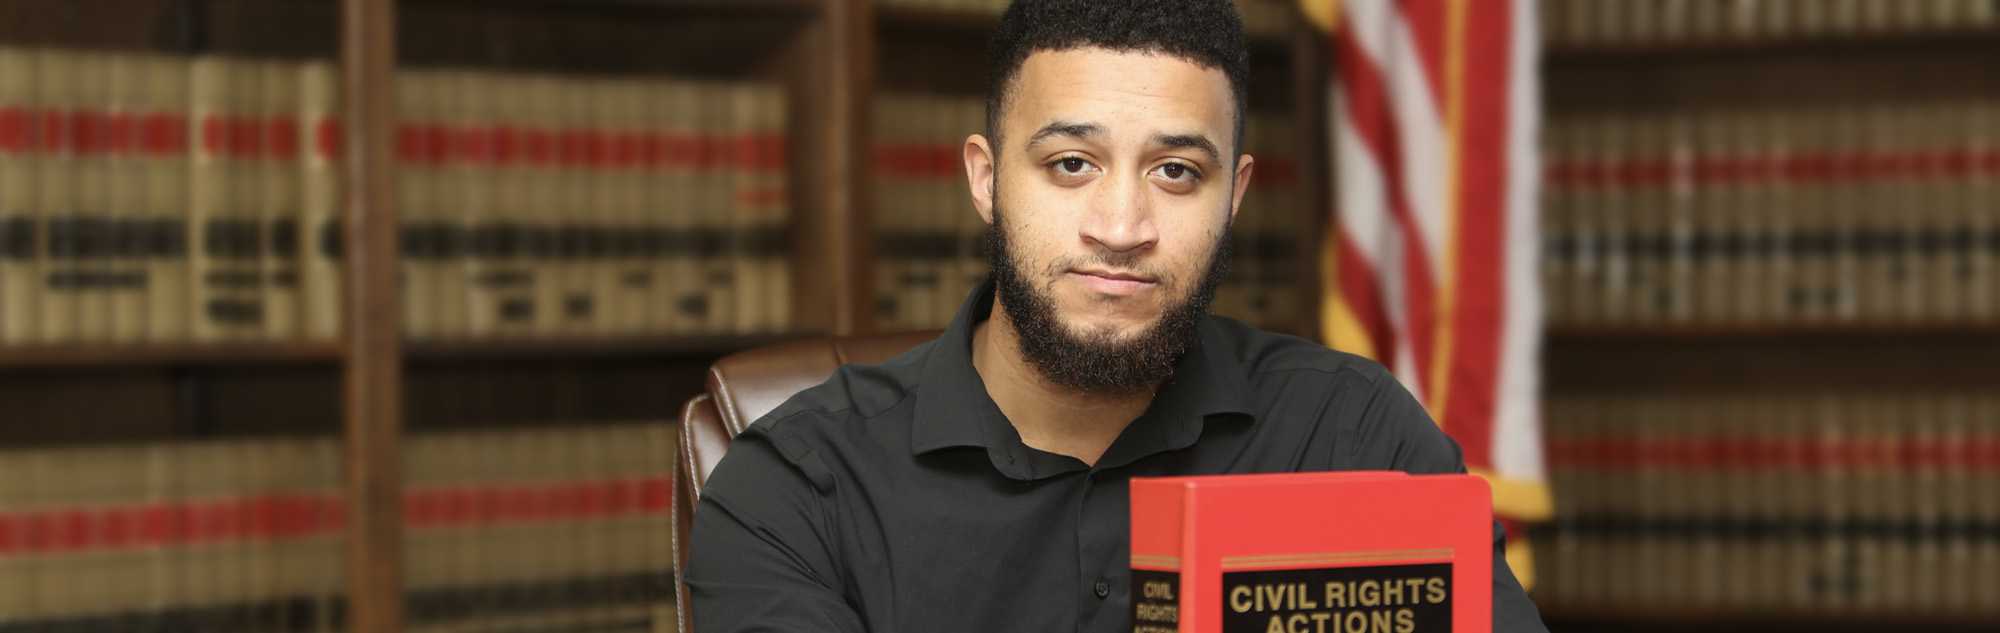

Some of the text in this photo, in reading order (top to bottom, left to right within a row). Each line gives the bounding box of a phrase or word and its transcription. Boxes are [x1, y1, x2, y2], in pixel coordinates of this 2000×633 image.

[1143, 581, 1174, 600] CIVIL
[1229, 577, 1446, 613] CIVIL RIGHTS
[1136, 603, 1179, 623] RIGHTS
[1265, 608, 1416, 633] ACTIONS
